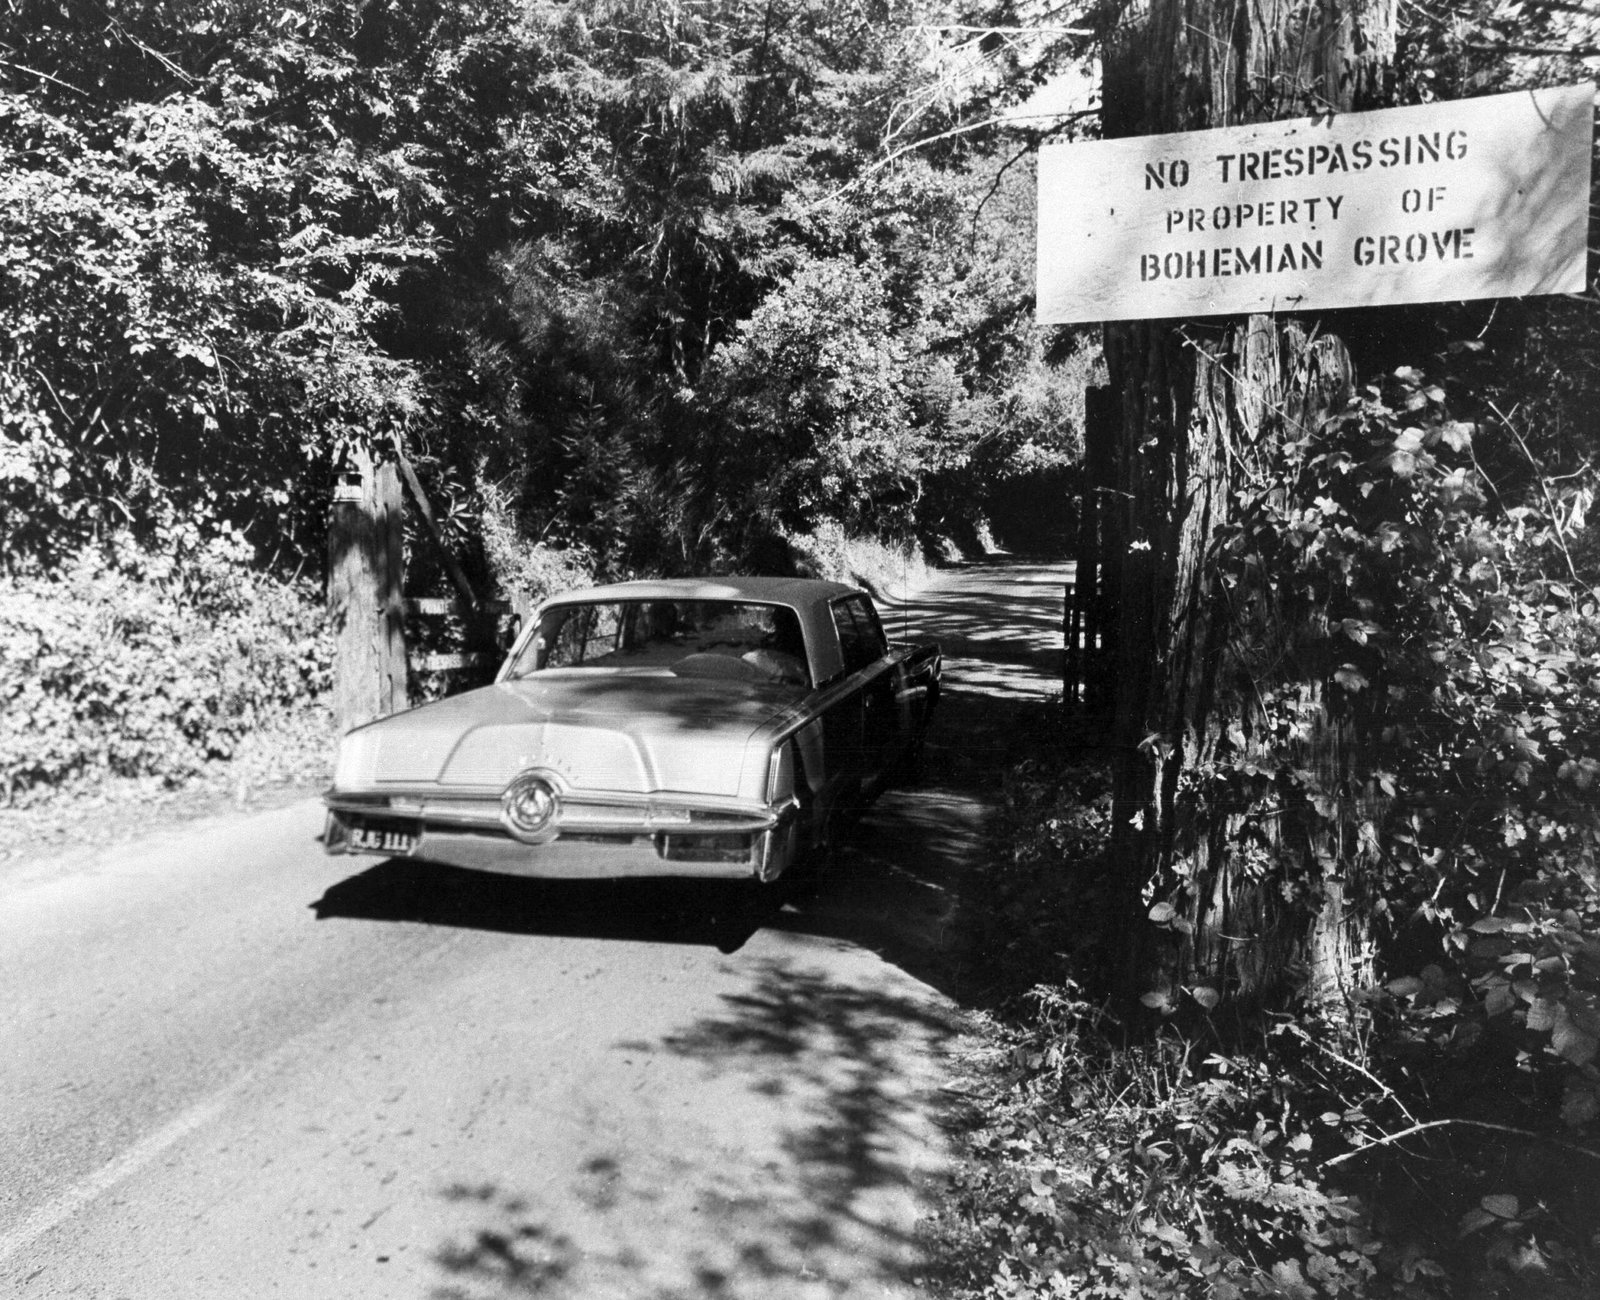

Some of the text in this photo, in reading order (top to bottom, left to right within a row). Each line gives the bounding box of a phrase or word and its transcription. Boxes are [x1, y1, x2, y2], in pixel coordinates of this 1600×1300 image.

[1145, 130, 1468, 191] NO TRESPASSING
[1166, 187, 1448, 234] PROPERTY OF
[1140, 227, 1476, 282] BOHEMIAN GROVE
